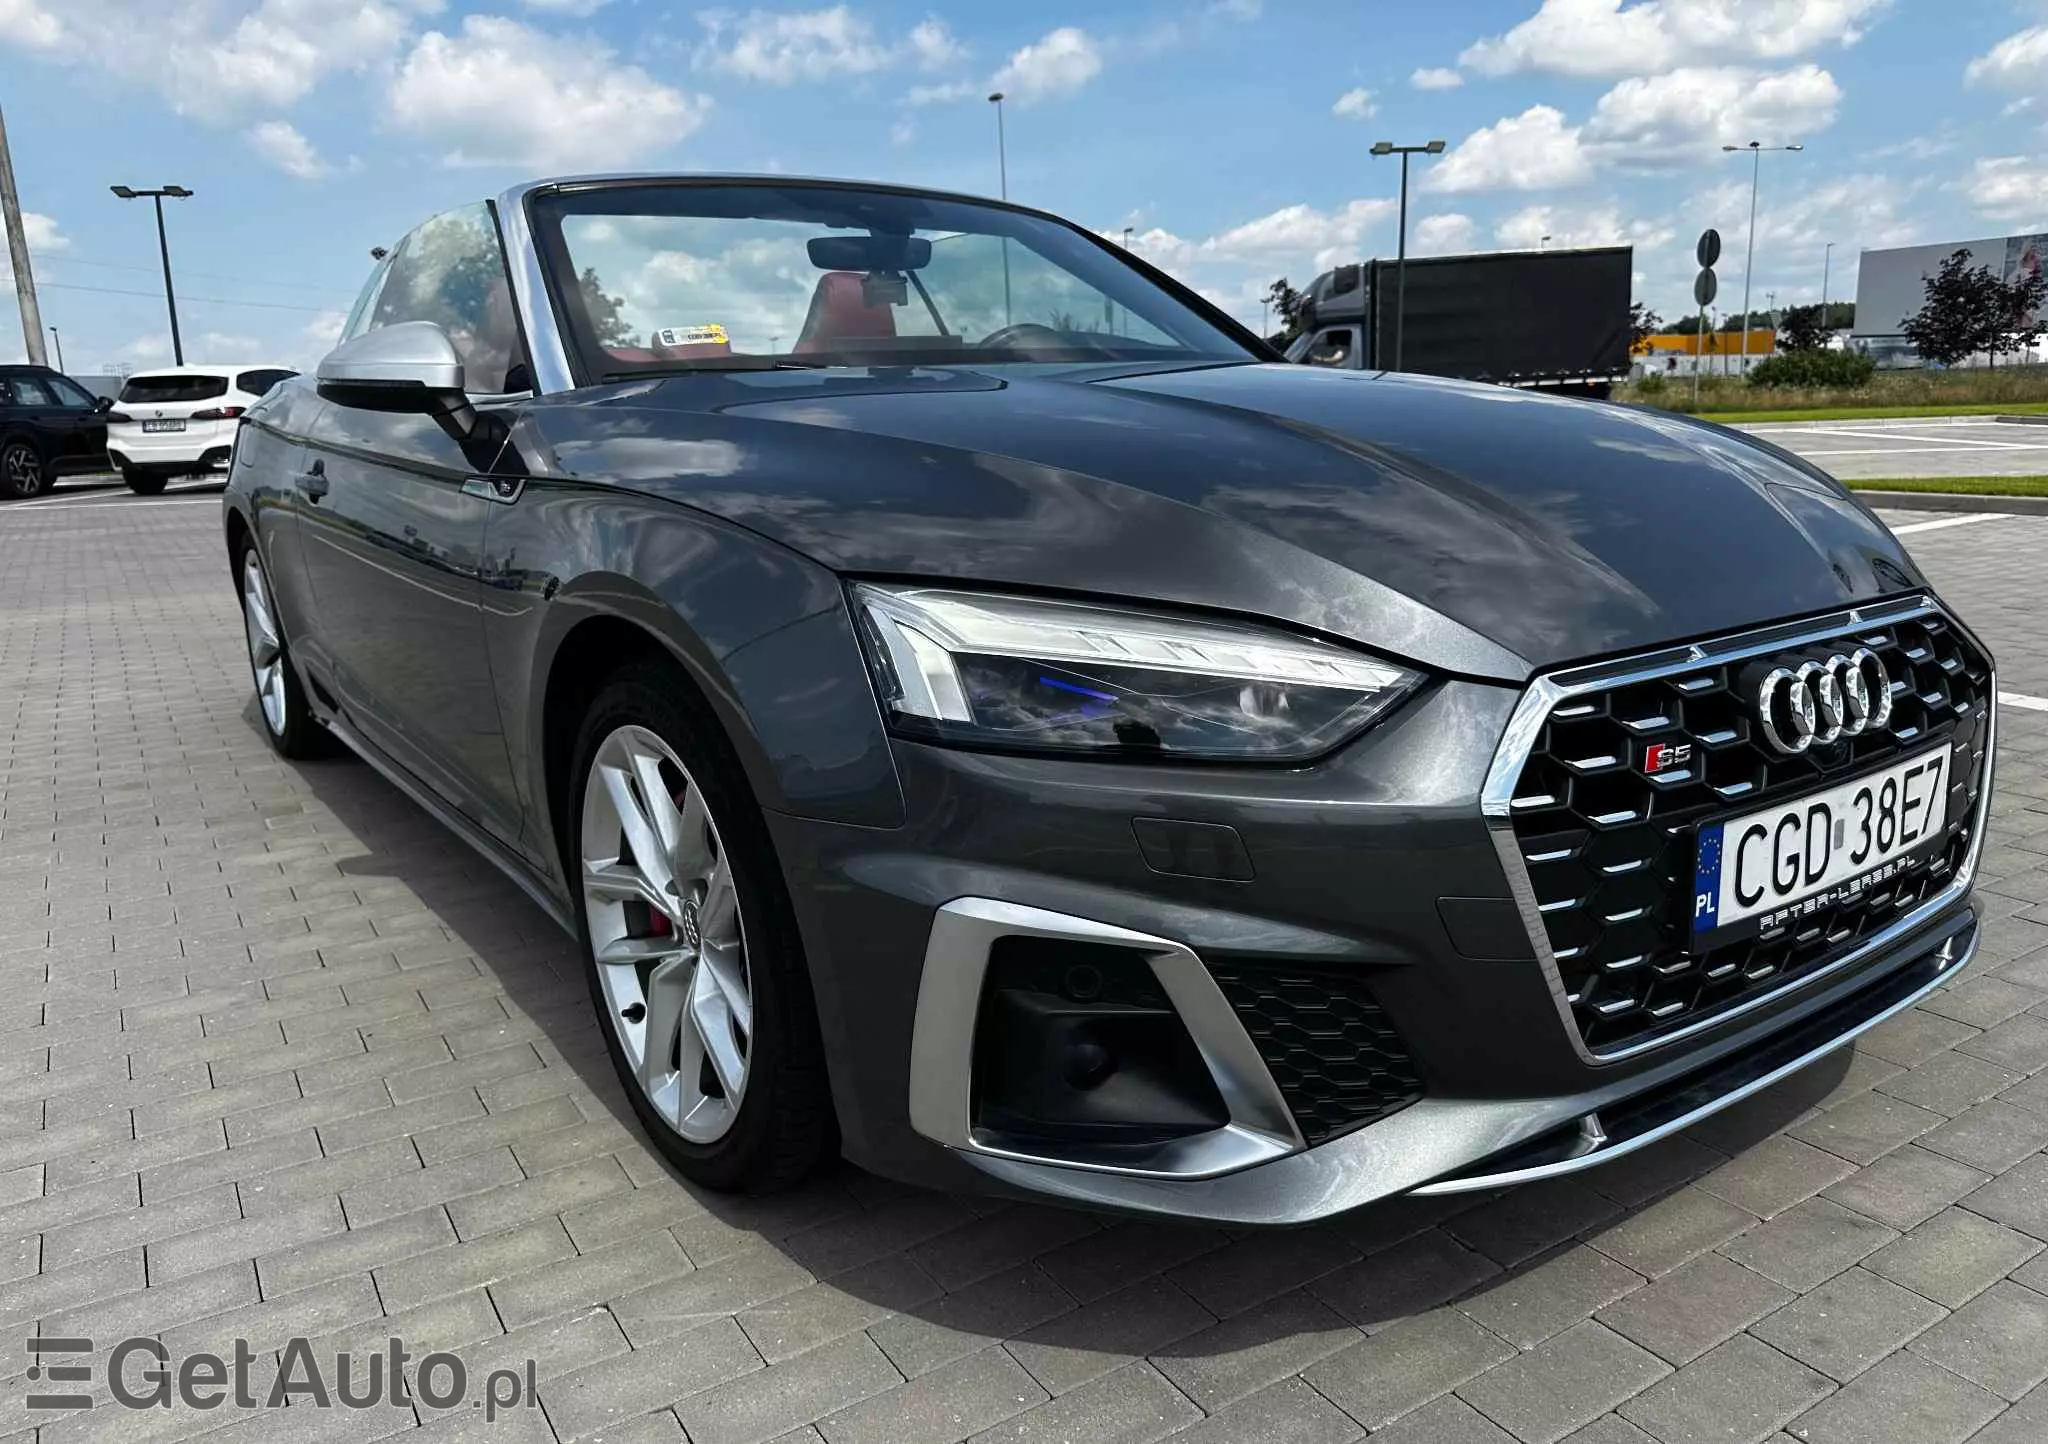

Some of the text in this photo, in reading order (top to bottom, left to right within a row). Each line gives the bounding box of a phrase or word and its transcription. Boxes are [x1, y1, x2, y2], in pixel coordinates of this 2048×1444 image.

[1657, 744, 1691, 768] S5
[1735, 755, 1943, 908] CGD 38E7
[1694, 894, 1715, 918] PL
